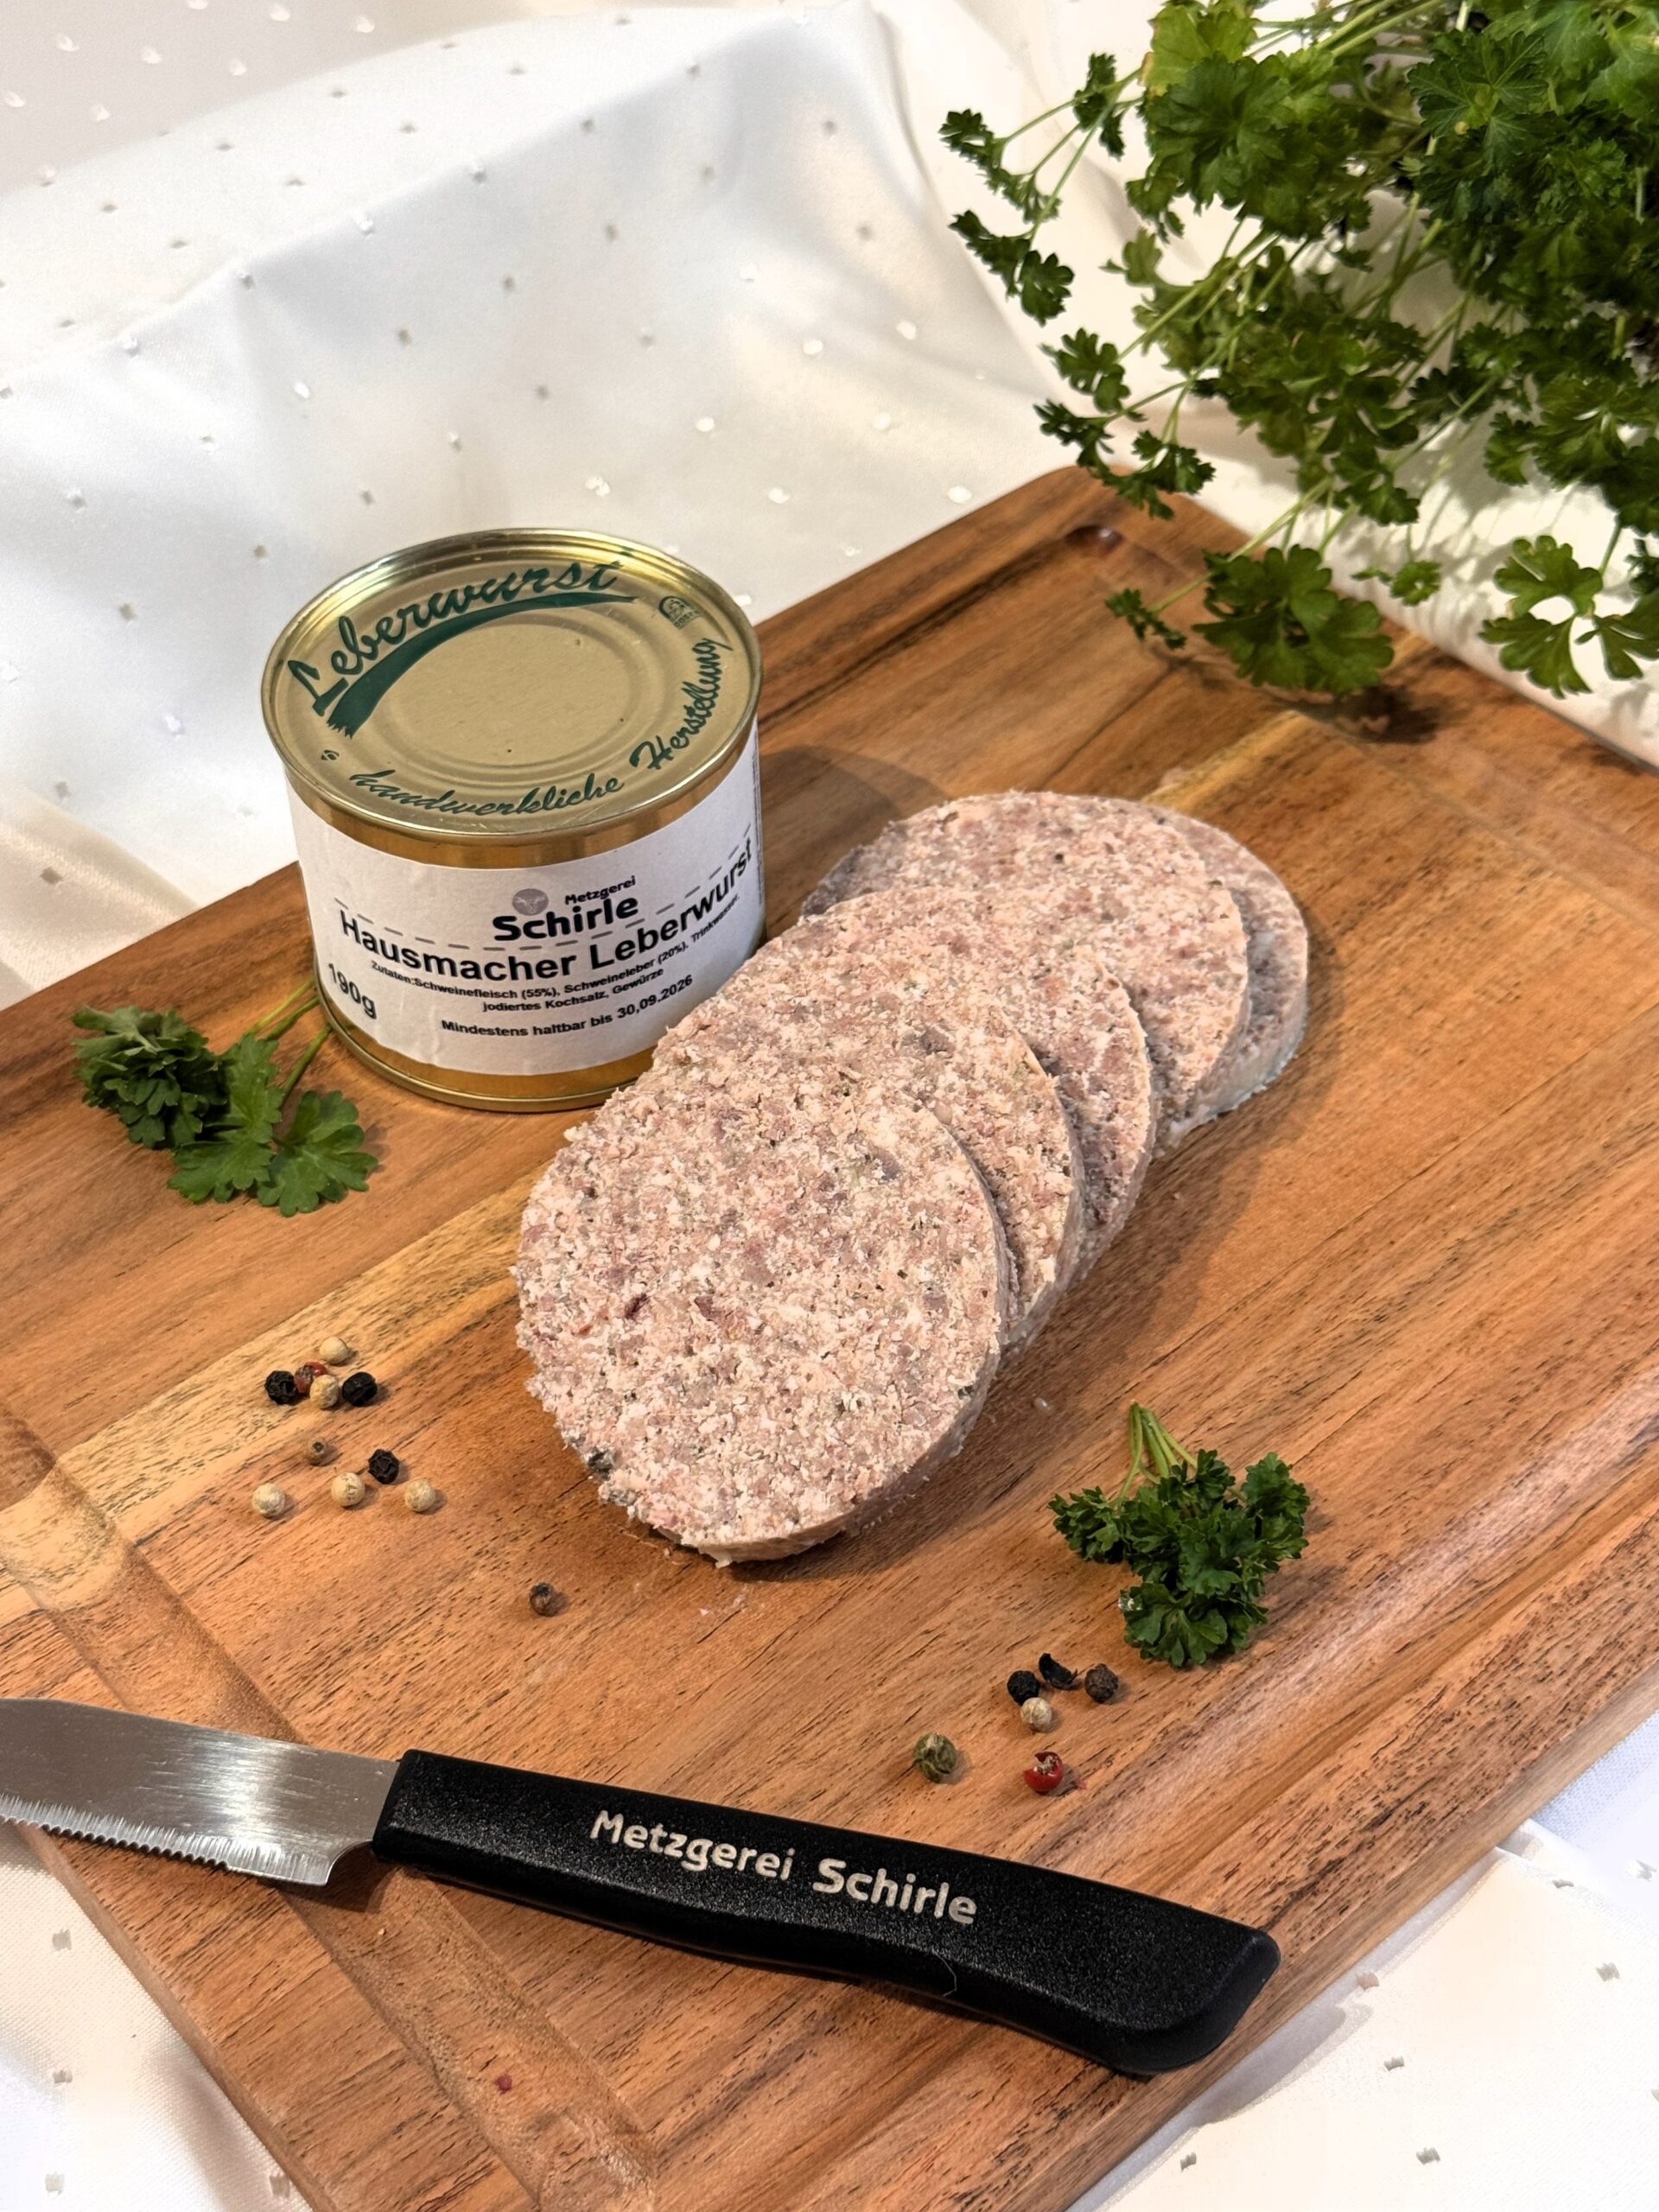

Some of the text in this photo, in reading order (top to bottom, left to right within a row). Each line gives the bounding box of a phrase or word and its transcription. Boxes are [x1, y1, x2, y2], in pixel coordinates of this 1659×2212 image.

[288, 559, 625, 716] Leberwurst
[351, 638, 734, 817] handwerkliche Herstellung
[340, 837, 751, 982] Hausmacher Leberwurst
[565, 875, 636, 905] Metzgerei
[493, 898, 639, 941] Schirle
[328, 963, 377, 1020] 190g
[483, 968, 664, 1013] jodiertes Kochsalz, Gewürze
[564, 959, 655, 994] Schweineleber
[442, 1019, 529, 1037] Mindestens
[532, 1020, 587, 1036] haltbar
[591, 1014, 613, 1028] bis
[589, 1809, 977, 1925] Metzgerei Schirle
